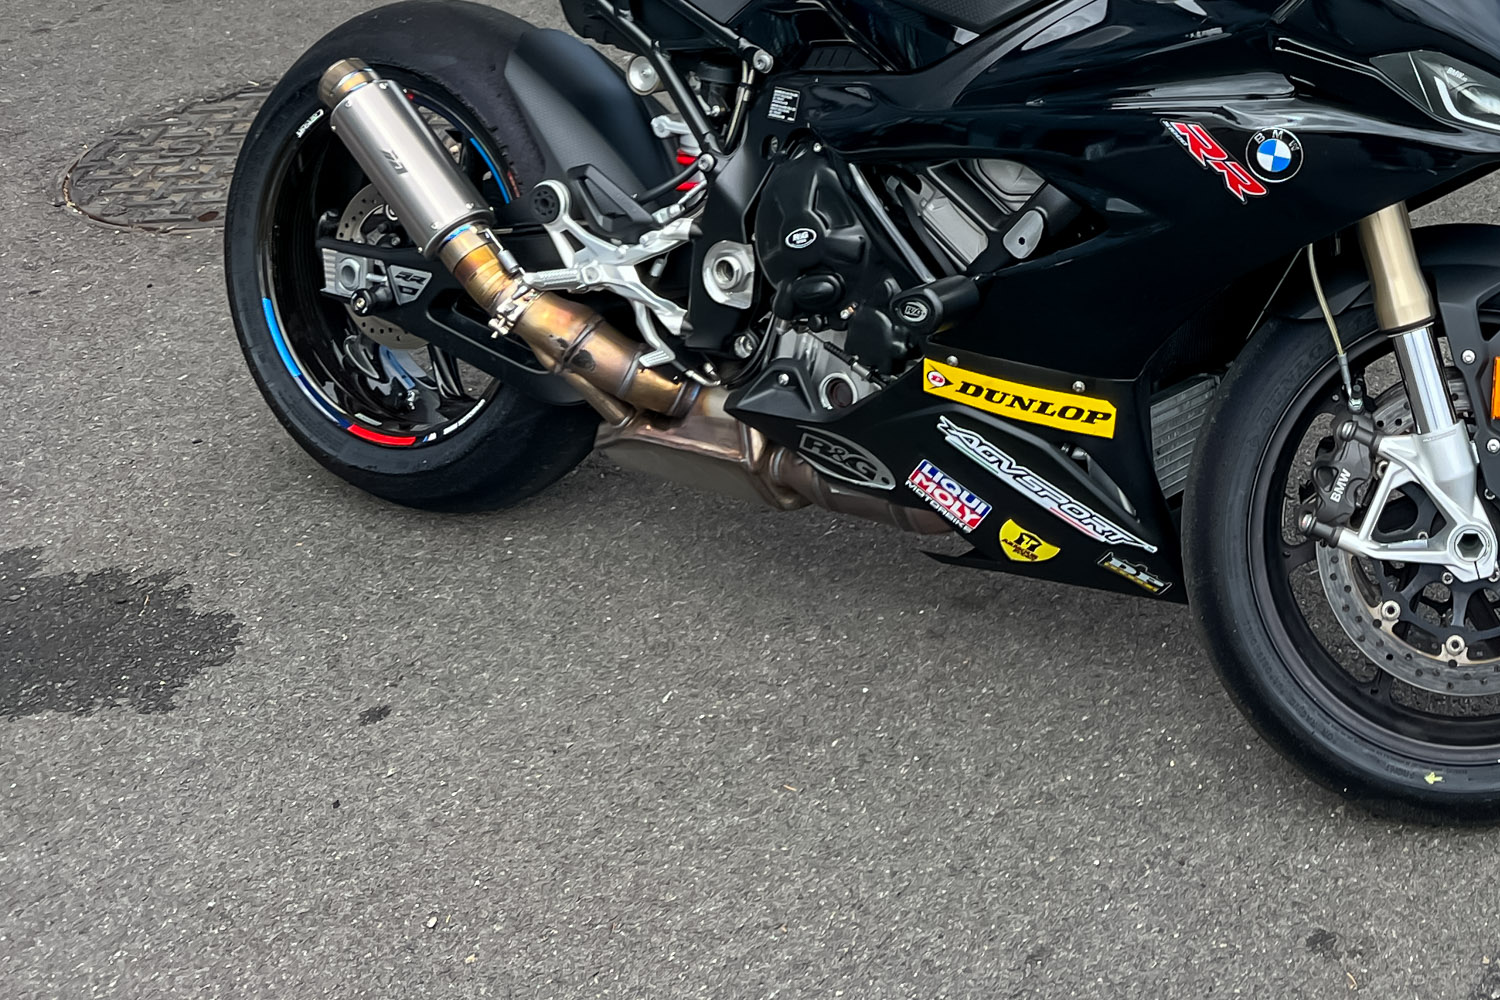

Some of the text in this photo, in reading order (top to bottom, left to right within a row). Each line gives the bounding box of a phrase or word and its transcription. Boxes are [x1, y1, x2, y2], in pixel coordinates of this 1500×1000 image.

[1170, 121, 1268, 202] RR
[954, 380, 1113, 425] DUNLOP
[913, 472, 982, 524] MOLY
[920, 463, 988, 515] LIQUI
[1330, 468, 1351, 503] BMW
